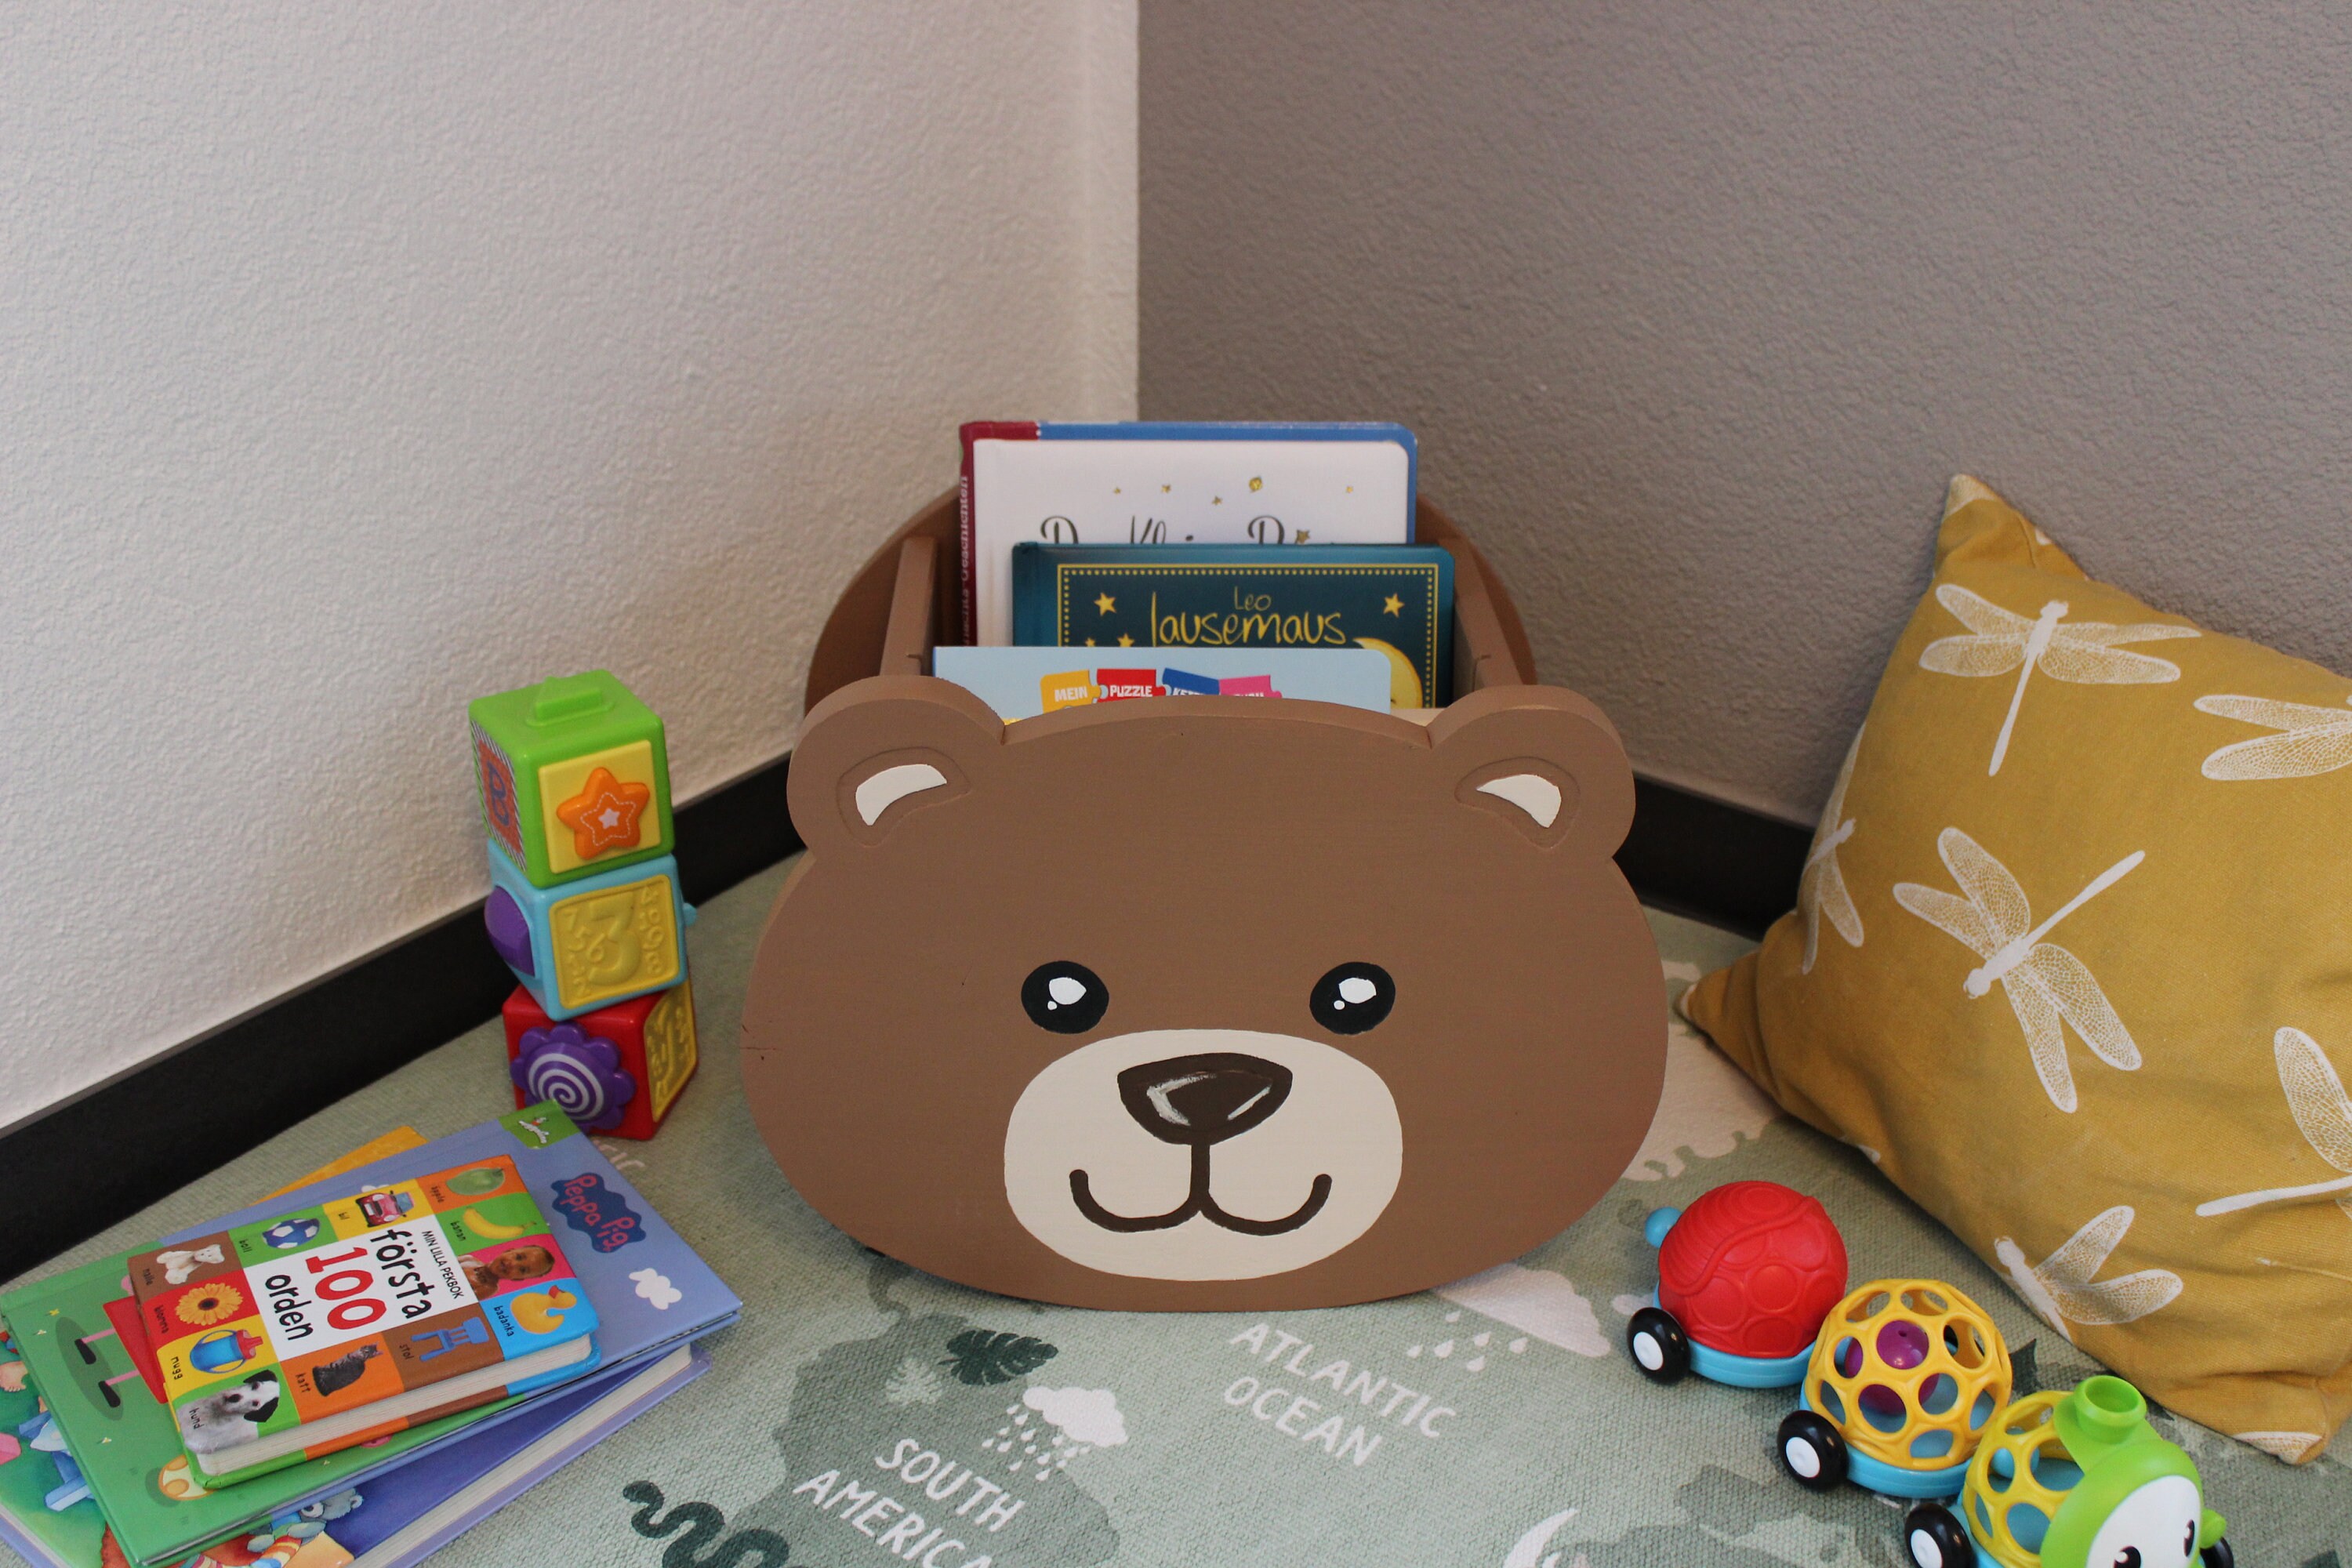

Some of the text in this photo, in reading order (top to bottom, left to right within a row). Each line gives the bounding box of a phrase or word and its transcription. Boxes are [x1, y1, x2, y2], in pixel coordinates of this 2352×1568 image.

[1234, 586, 1272, 611] Leo
[1054, 684, 1153, 702] MEIN PUZZLE
[588, 890, 641, 986] 3
[238, 1238, 252, 1254] boll
[450, 1221, 466, 1242] banan
[560, 1174, 636, 1251] Peppa Pig
[306, 1247, 387, 1330] 100
[370, 1229, 435, 1319] första
[422, 1230, 465, 1300] MIN LILLA PEKBOK
[265, 1274, 314, 1341] orden
[171, 1356, 183, 1380] mugg
[296, 1372, 311, 1392] katt
[399, 1344, 415, 1359] stol
[1229, 1323, 1456, 1438] ATLANTIC
[189, 1407, 205, 1429] hund
[1224, 1376, 1383, 1467] OCEAN
[875, 1438, 1025, 1532] SOUTH
